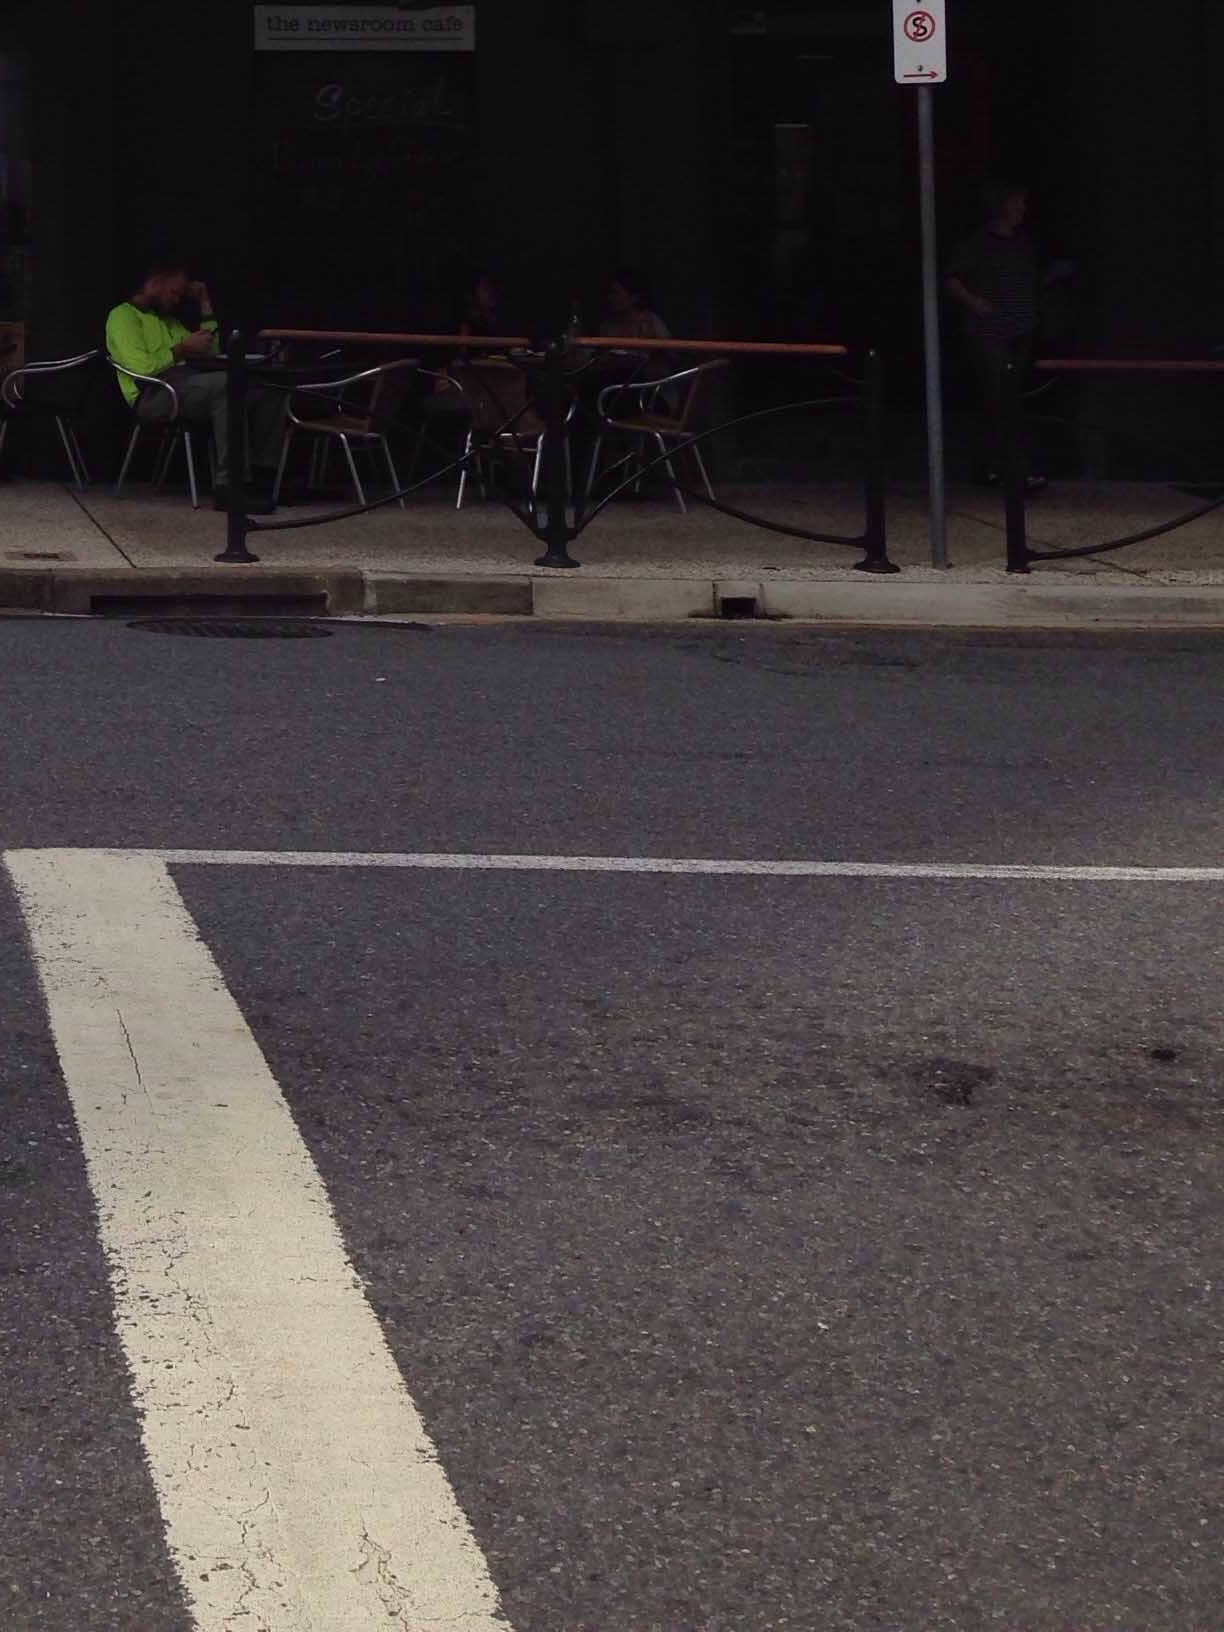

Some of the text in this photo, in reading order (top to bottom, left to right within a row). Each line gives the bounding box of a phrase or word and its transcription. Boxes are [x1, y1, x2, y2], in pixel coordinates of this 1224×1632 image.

[266, 15, 464, 32] the newsroom cafe
